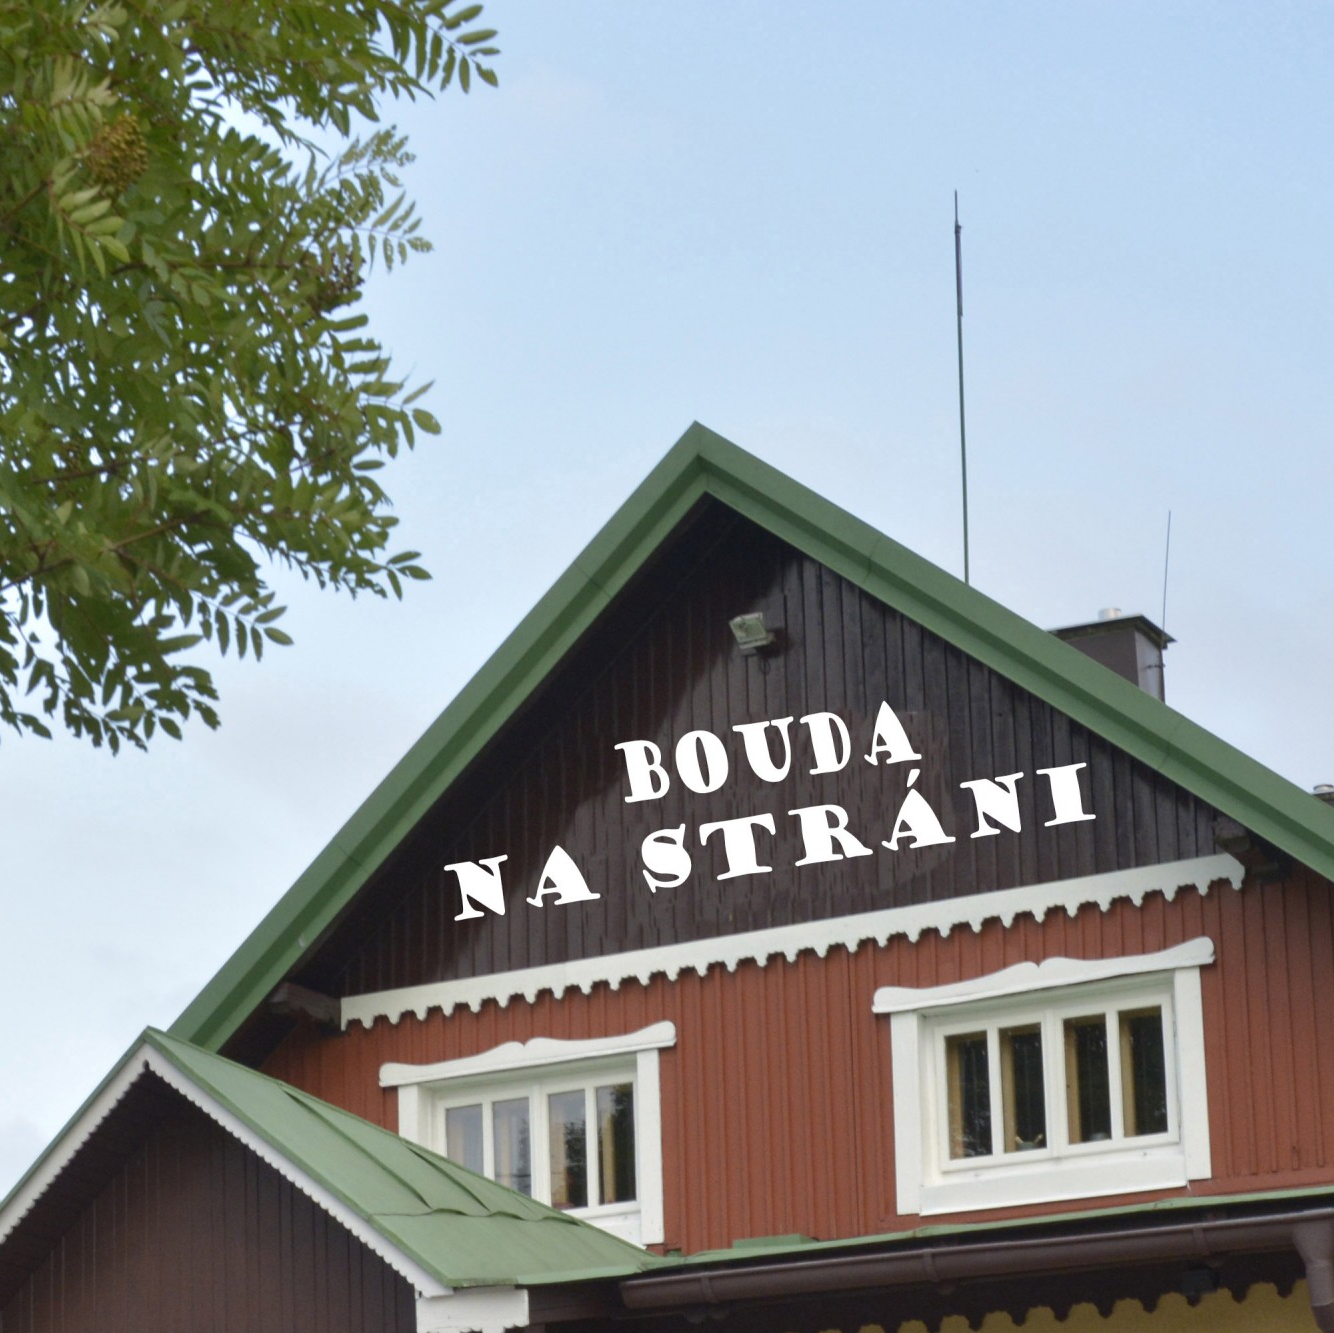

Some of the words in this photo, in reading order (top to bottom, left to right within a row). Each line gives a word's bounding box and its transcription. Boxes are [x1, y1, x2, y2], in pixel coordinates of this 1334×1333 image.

[613, 699, 923, 804] BOUDA
[443, 844, 601, 922] NA
[640, 762, 1097, 894] STRÁNI
